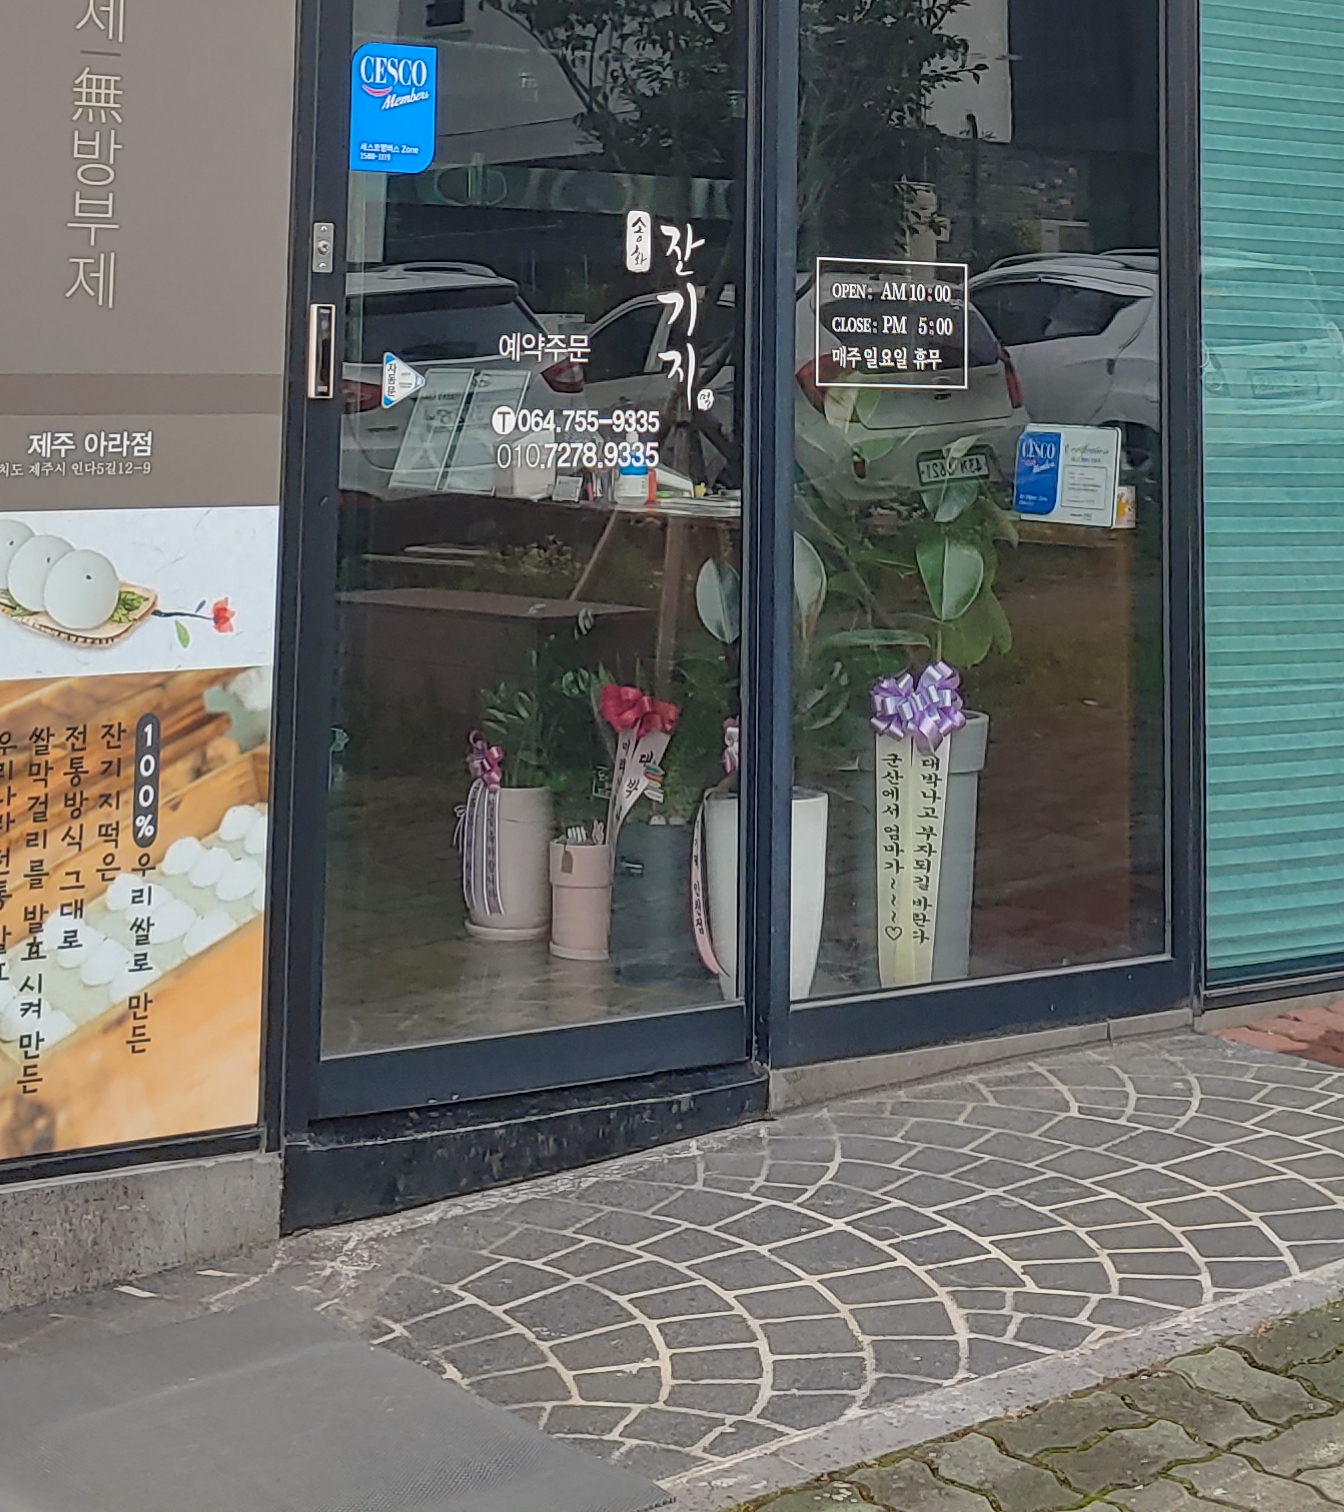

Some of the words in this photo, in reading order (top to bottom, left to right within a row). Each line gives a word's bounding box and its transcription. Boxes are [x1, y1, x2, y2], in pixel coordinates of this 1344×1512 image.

[360, 56, 427, 86] CESCO
[381, 87, 429, 111] Members
[401, 145, 419, 154] Zone
[64, 66, 124, 310] 無방부제
[632, 216, 647, 265] 송화
[881, 282, 907, 300] AM
[909, 284, 951, 302] 10:00
[657, 223, 706, 411] 잔기지
[882, 315, 907, 334] PM
[918, 317, 953, 336] 5:00
[499, 333, 591, 363] 예약주문
[832, 345, 862, 369] 매주
[864, 346, 907, 370] 일요일
[913, 348, 943, 371] 휴무
[387, 363, 397, 397] 자동문
[518, 410, 660, 433] 064.755-9335
[27, 432, 76, 458] 제주
[84, 431, 153, 457] 아라점
[496, 442, 660, 469] 010.7278.9335
[28, 461, 66, 476] 제주시
[71, 461, 151, 476] 인다5길12-9
[60, 724, 89, 853] 전통방식
[135, 723, 156, 838] 100%
[881, 752, 904, 820] 군산에서
[916, 756, 942, 820] 대박나고
[96, 721, 127, 882] 잔기지떡은
[913, 825, 938, 892] 부자되길
[57, 869, 86, 950] 그대로
[126, 992, 153, 1054] 만든
[17, 1030, 45, 1094] 만든
